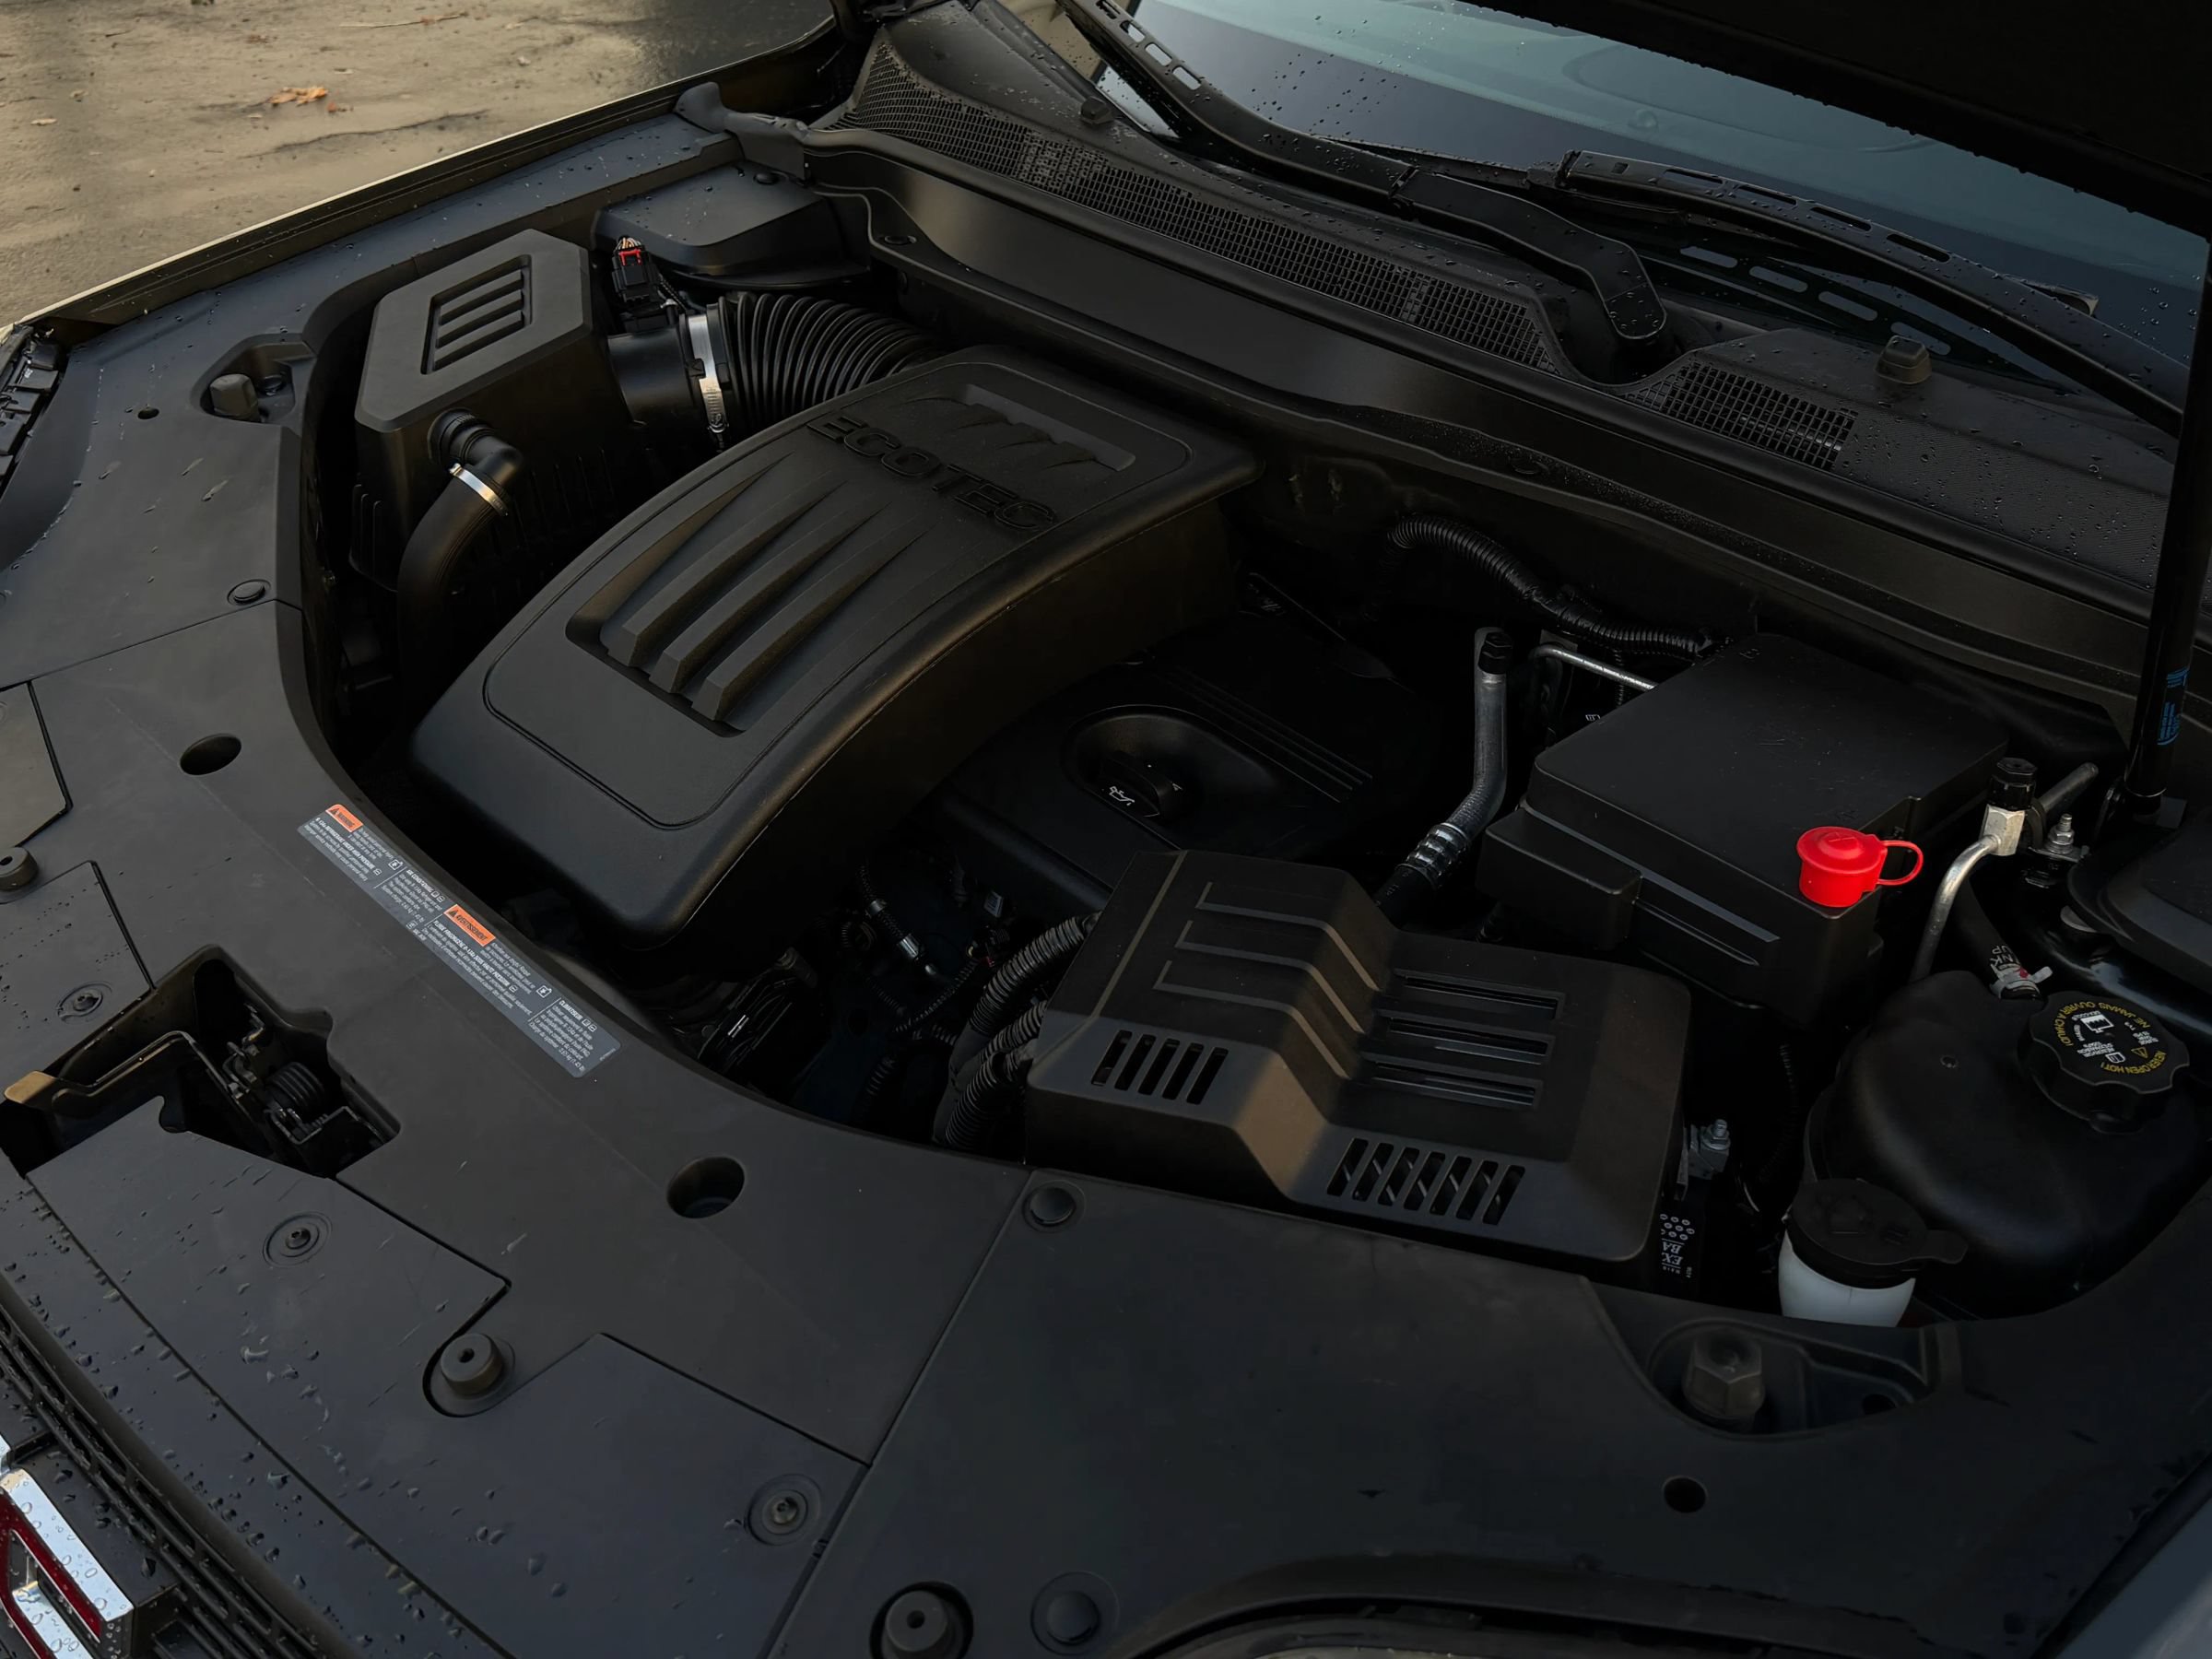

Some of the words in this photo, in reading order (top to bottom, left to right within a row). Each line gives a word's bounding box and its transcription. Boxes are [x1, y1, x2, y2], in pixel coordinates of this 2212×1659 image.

[804, 415, 1058, 530] ECOTEC
[455, 914, 488, 941] AVERTISSEMENT
[2060, 1001, 2095, 1014] OUVRIR
[2098, 1003, 2136, 1018] JAMAIS
[2135, 1017, 2151, 1029] NE
[2151, 1050, 2168, 1070] NEVER
[2124, 1065, 2151, 1075] OPEN
